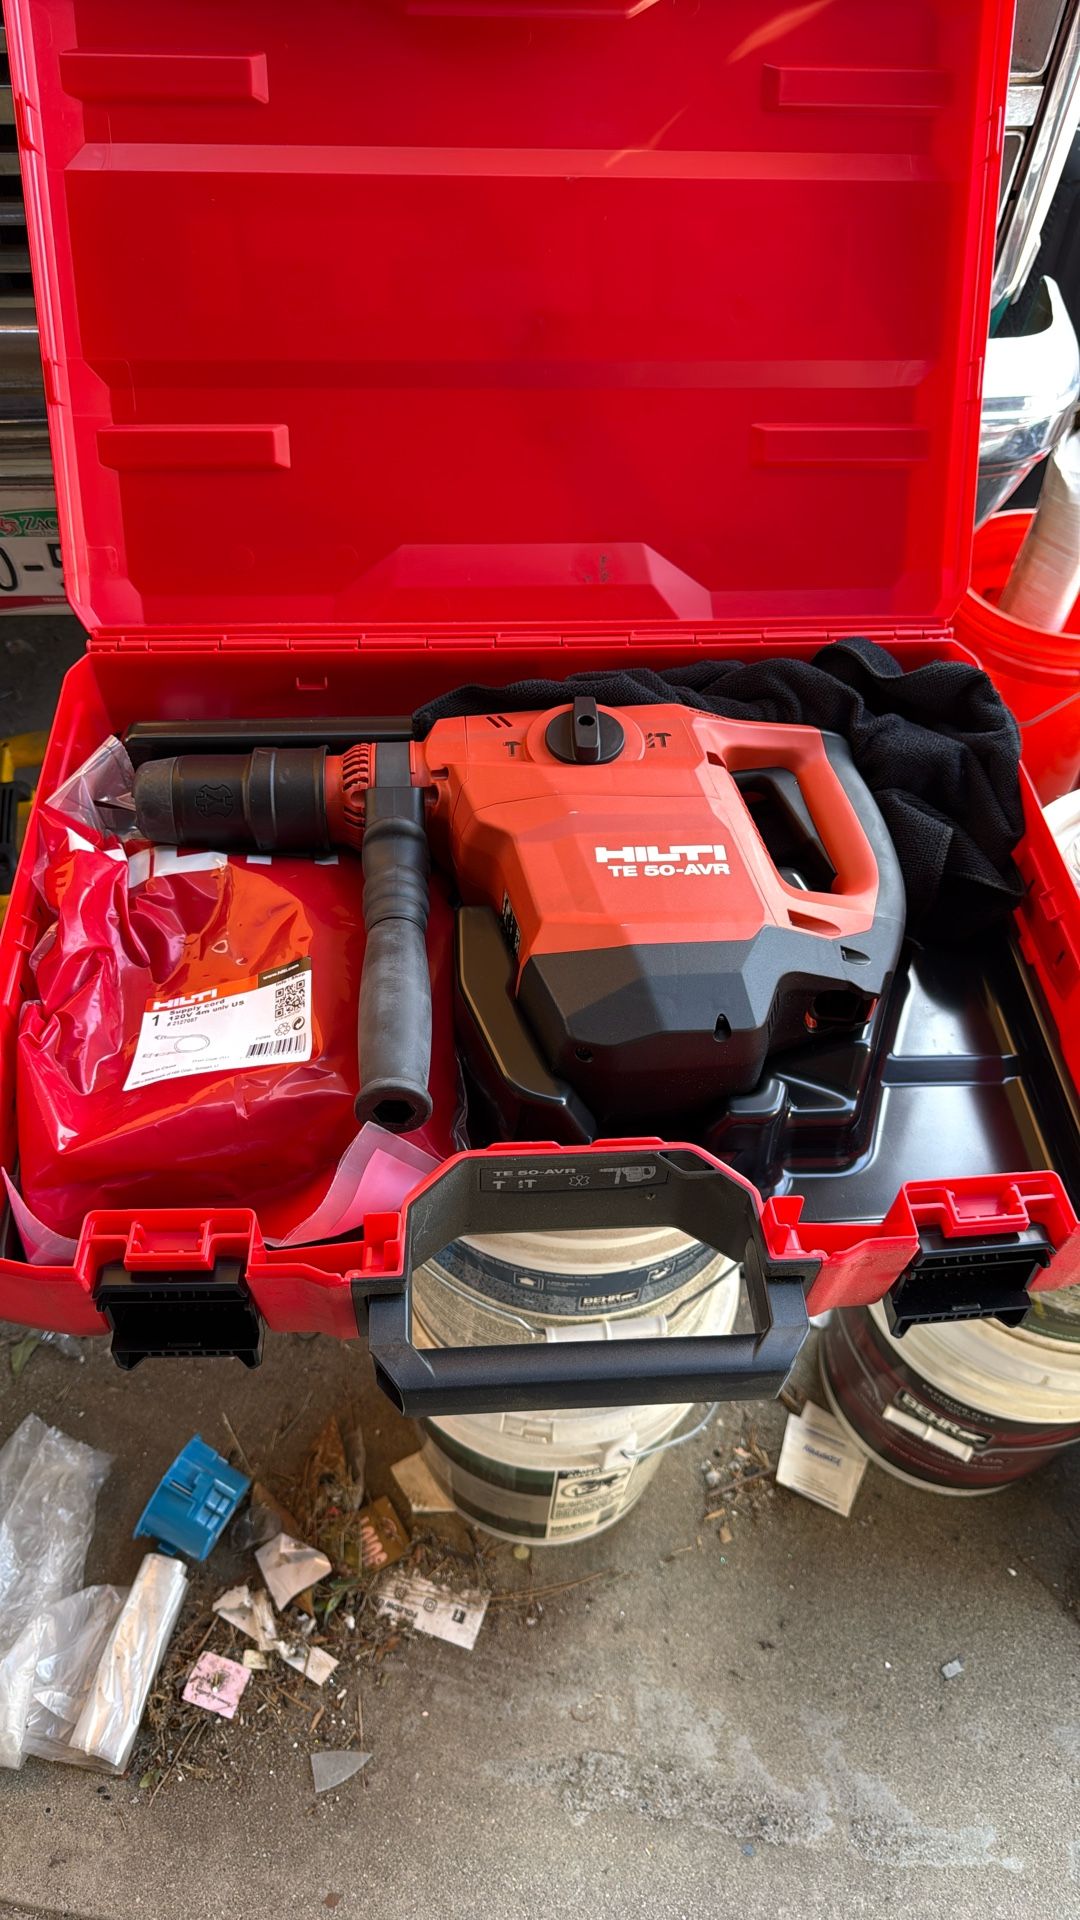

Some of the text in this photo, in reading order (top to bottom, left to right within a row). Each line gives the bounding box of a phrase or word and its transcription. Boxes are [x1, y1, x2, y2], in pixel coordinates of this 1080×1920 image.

[594, 844, 727, 862] HILTI
[608, 863, 731, 877] TE 50-AVR
[153, 988, 218, 1010] HILTI
[169, 999, 226, 1016] Supply cord
[168, 1012, 193, 1021] 120V
[231, 1000, 245, 1008] US
[152, 1014, 160, 1027] 1
[517, 1168, 577, 1176] 50-AVR
[582, 1292, 622, 1306] BEHR
[901, 1393, 962, 1434] BEHR
